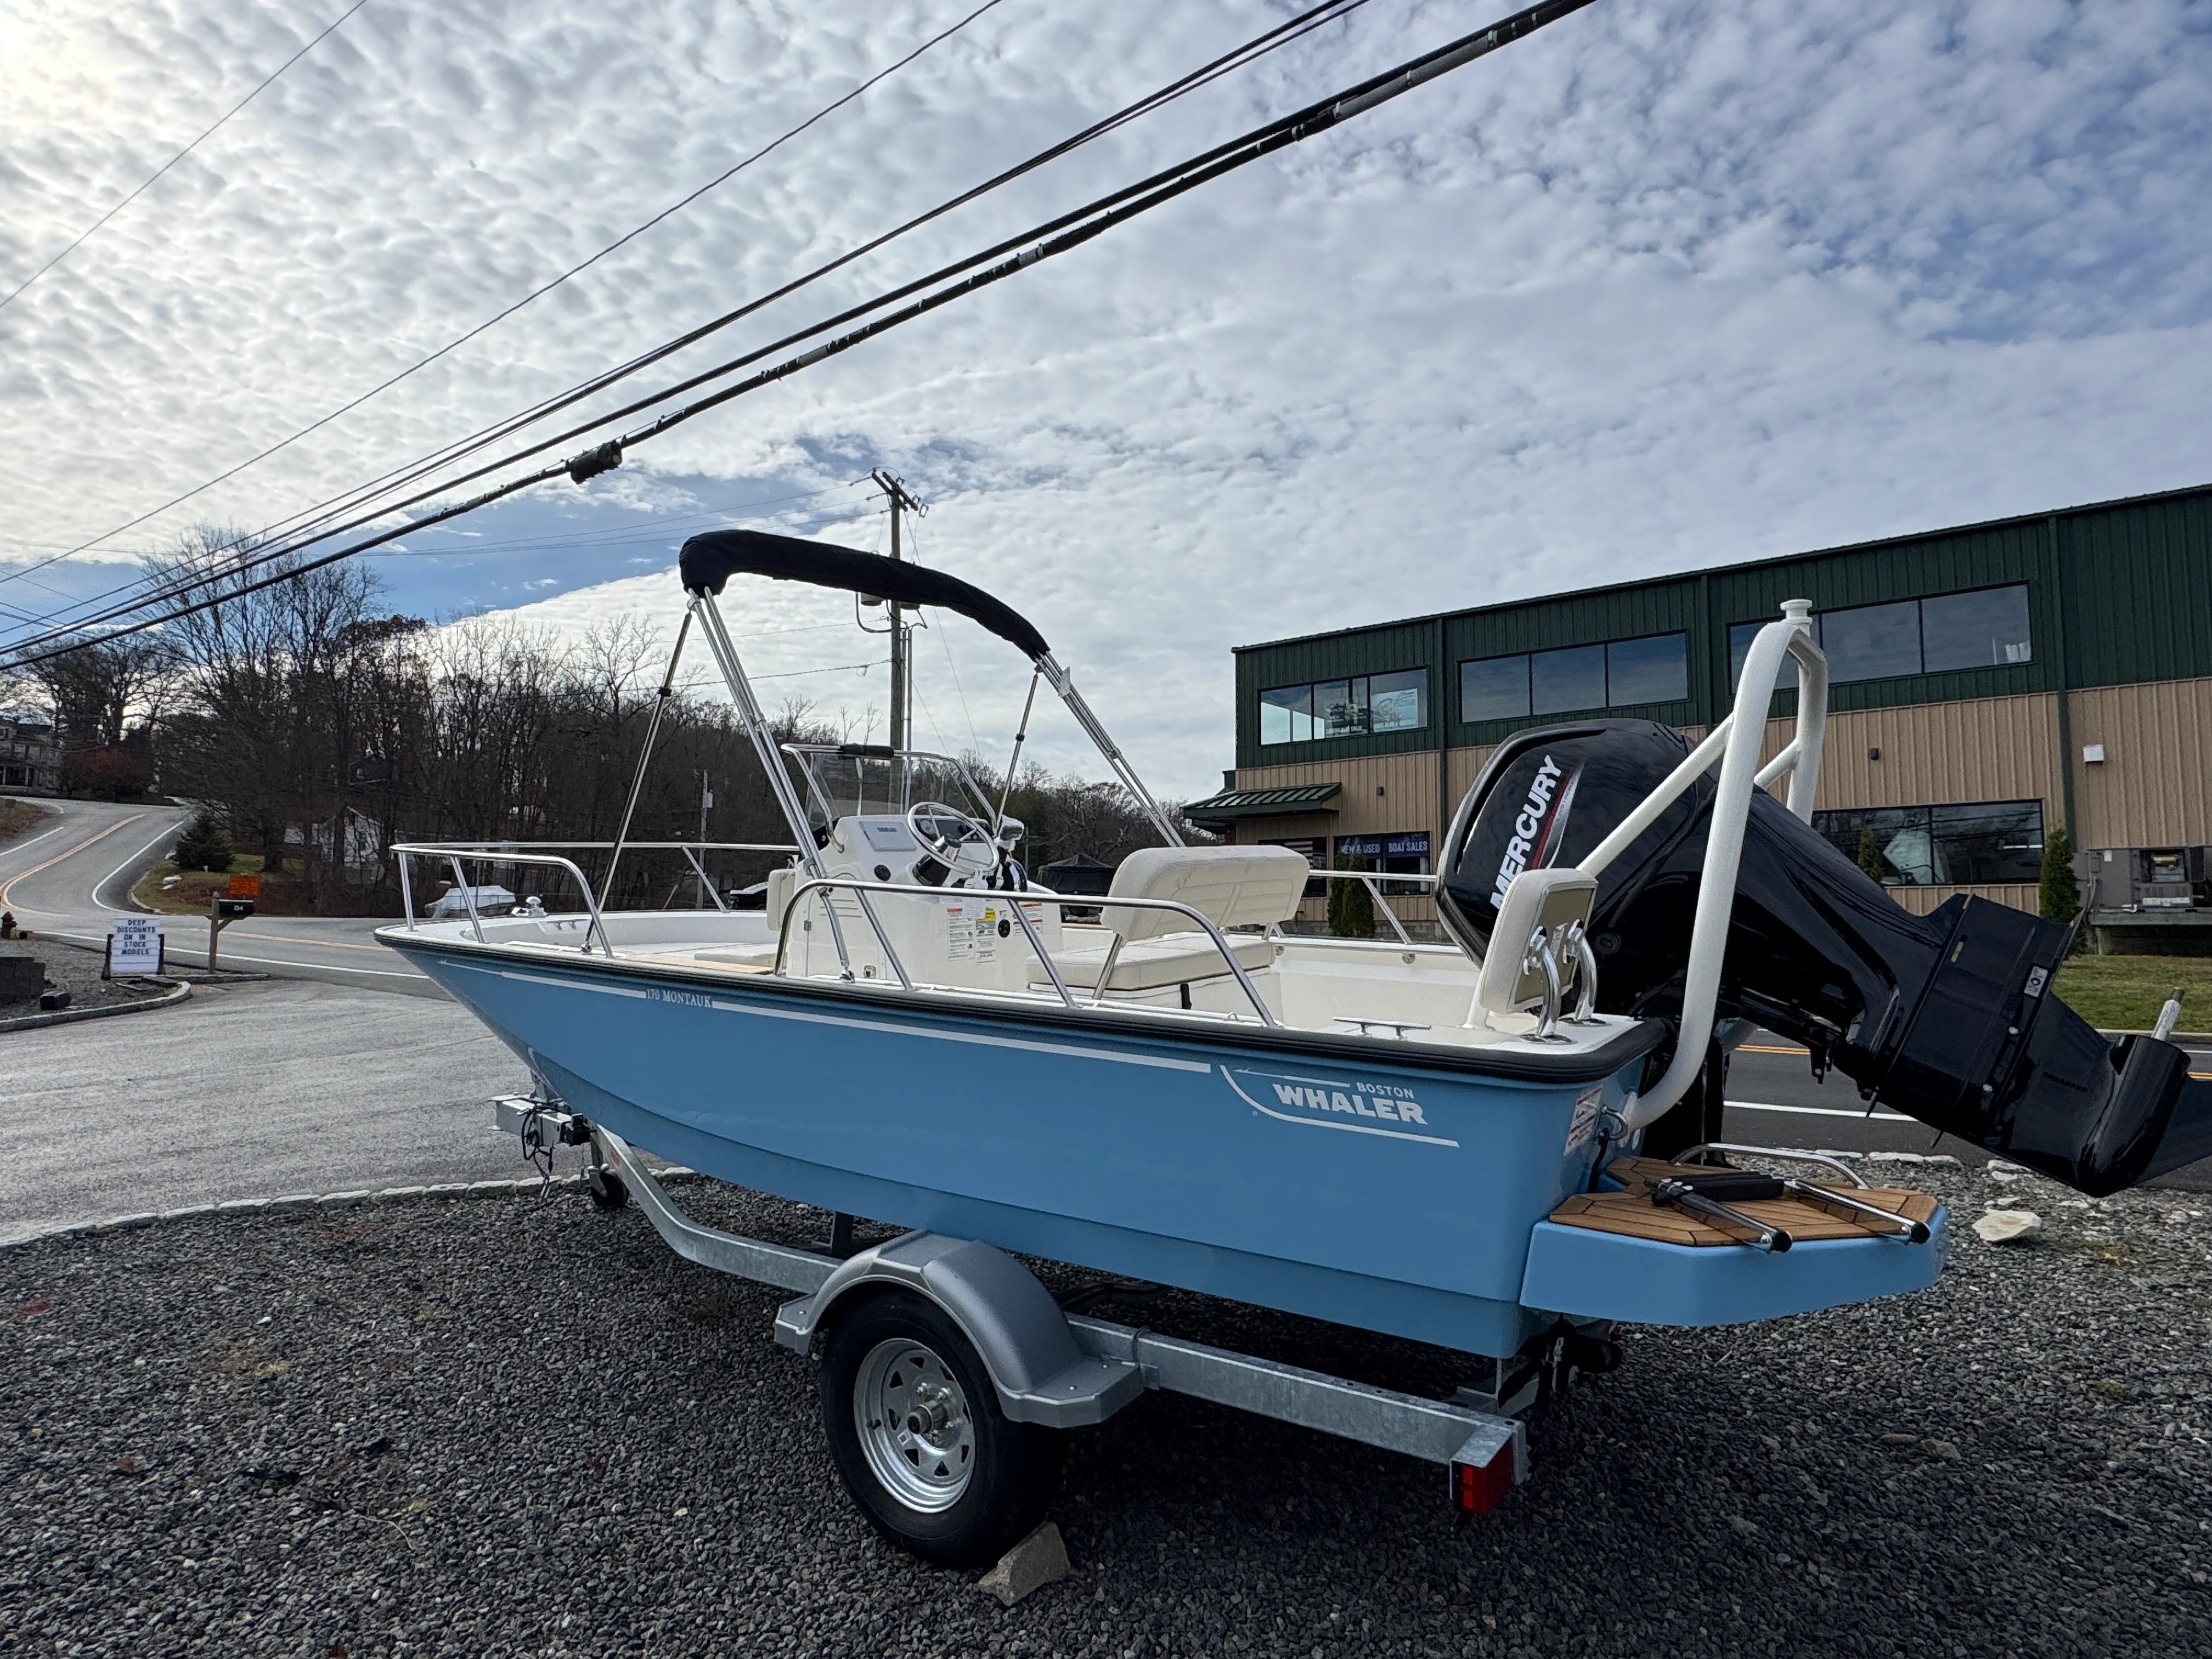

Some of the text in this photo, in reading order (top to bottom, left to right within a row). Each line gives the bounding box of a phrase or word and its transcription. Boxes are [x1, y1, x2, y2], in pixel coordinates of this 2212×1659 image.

[1490, 755, 1561, 909] MERCURY
[1363, 844, 1380, 854] USED
[1388, 842, 1404, 852] BOAT
[1406, 840, 1427, 851] SALES
[646, 989, 712, 1008] 170 MONTAUK
[1356, 1082, 1414, 1099] BOSTON
[1272, 1084, 1428, 1125] WHALER
